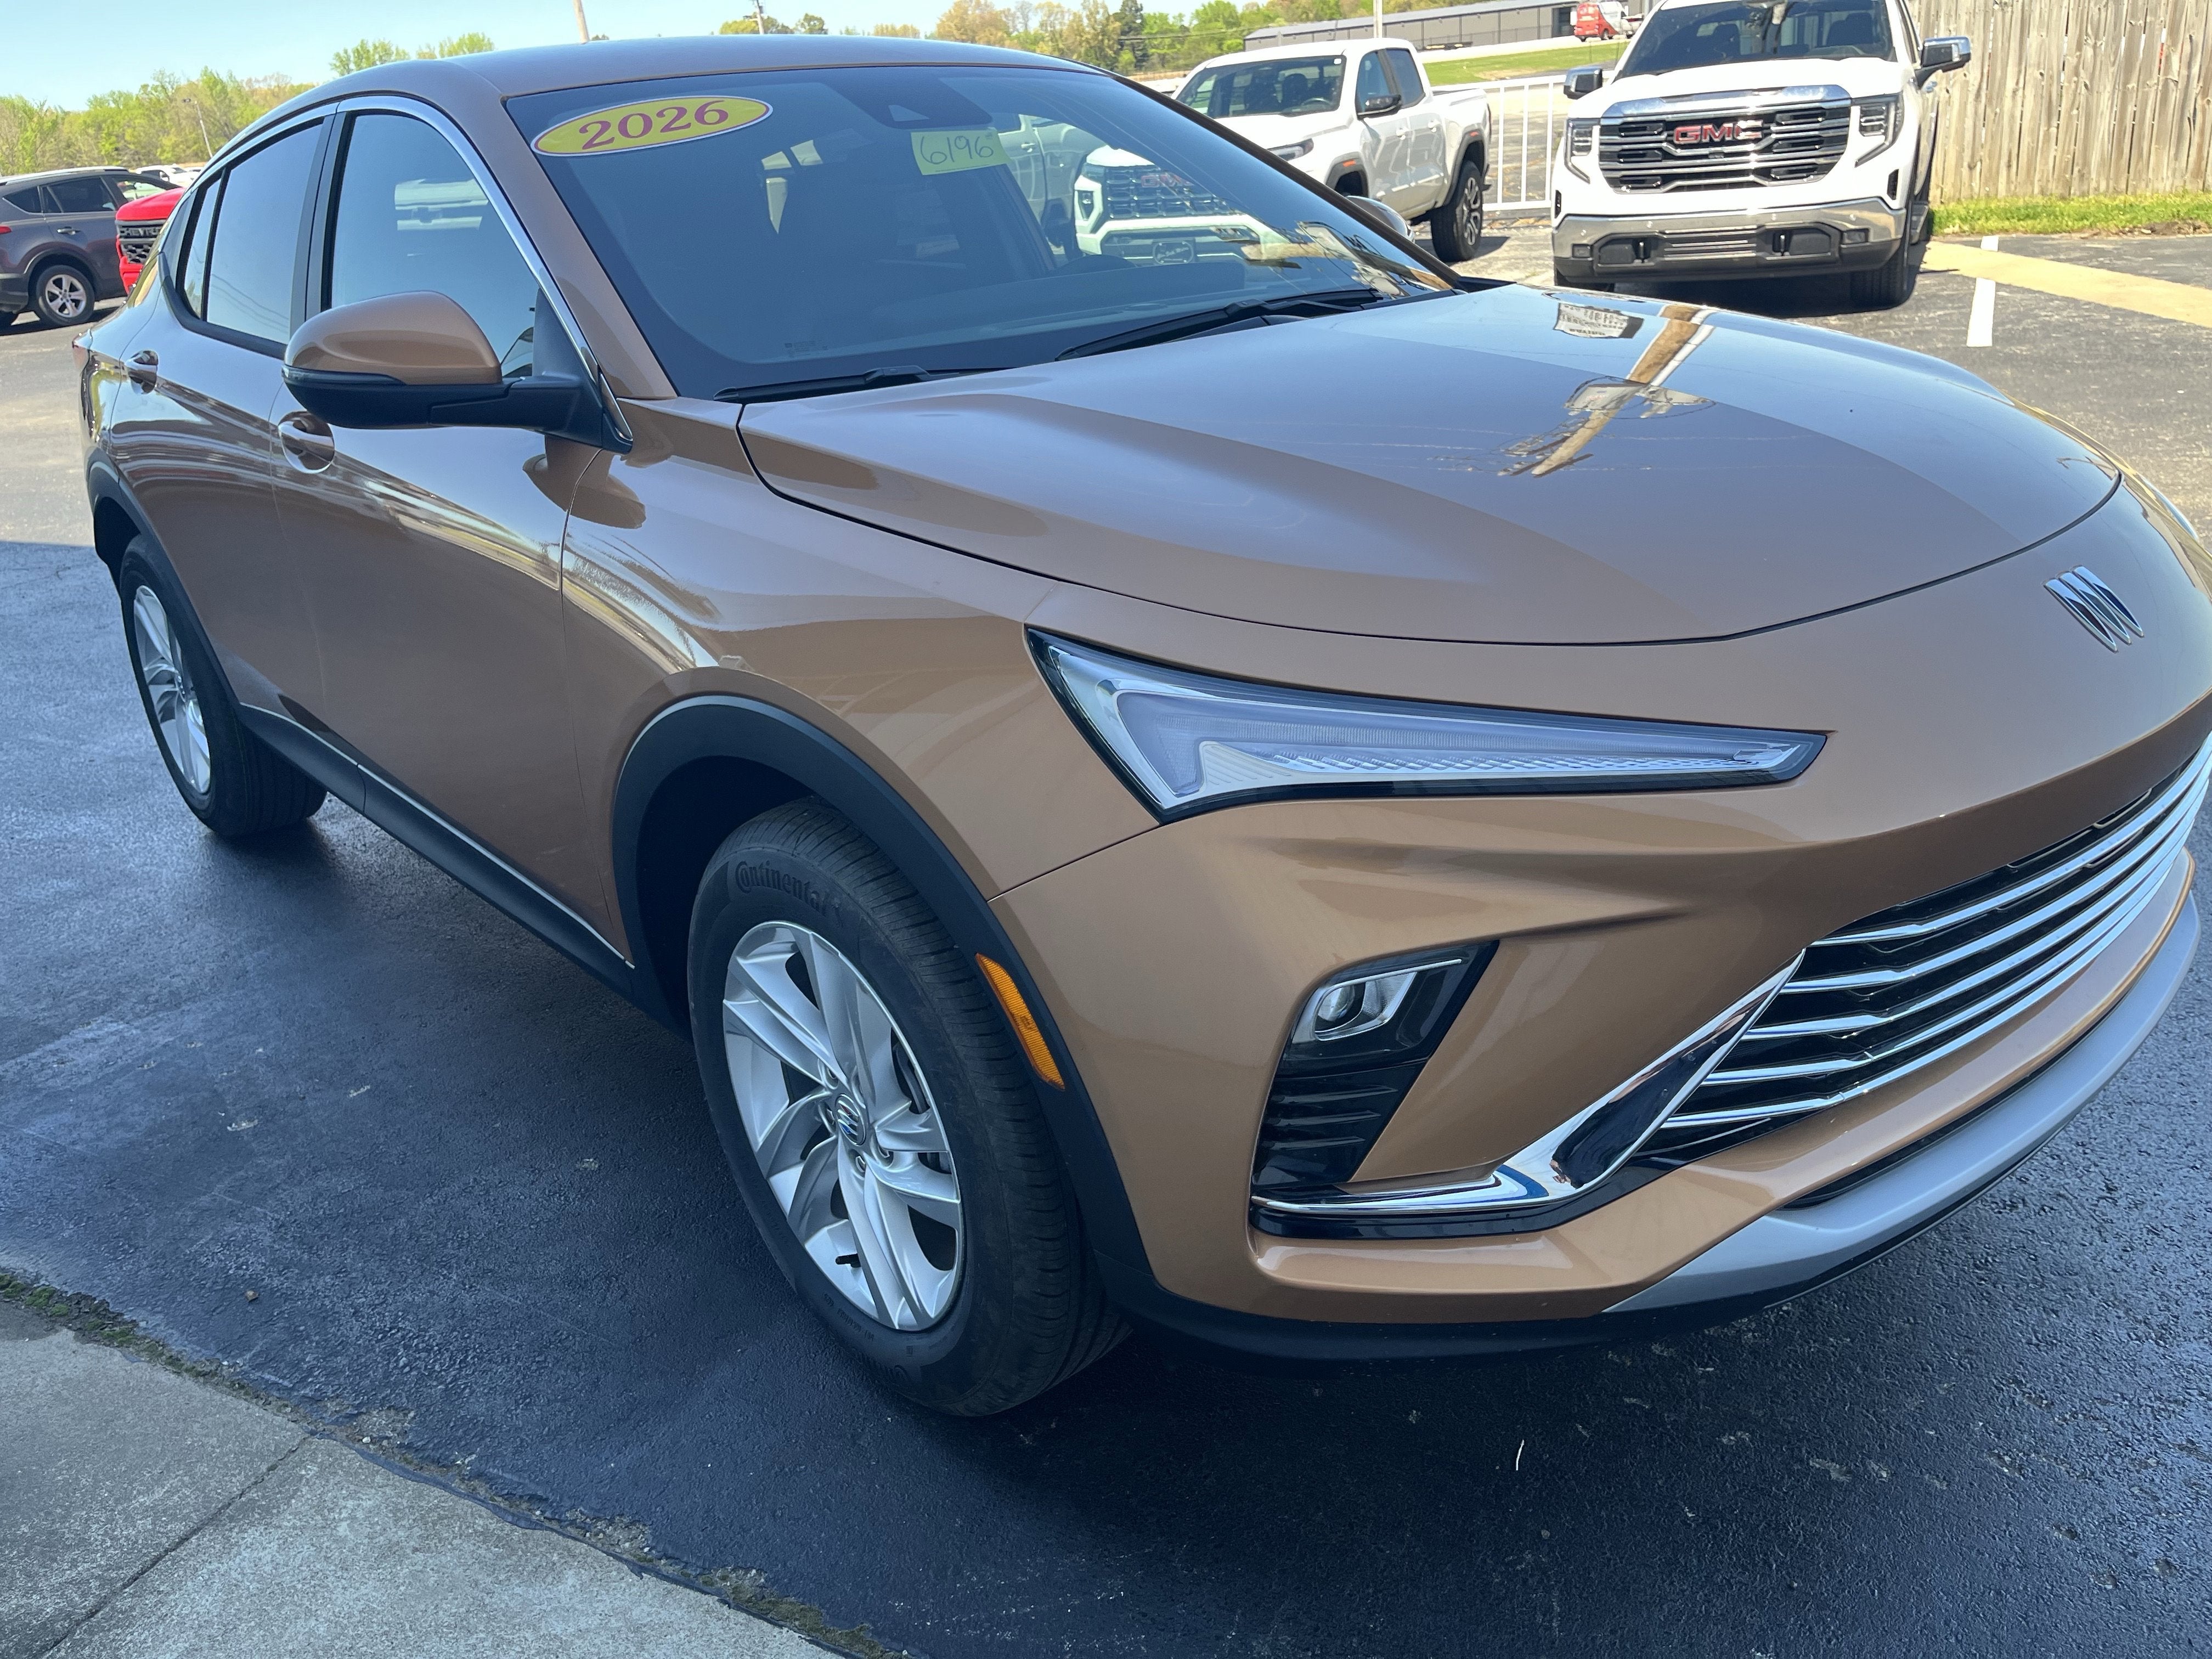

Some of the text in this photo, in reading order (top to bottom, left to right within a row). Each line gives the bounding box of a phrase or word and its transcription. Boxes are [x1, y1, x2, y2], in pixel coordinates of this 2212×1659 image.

[579, 100, 729, 150] 2026
[1674, 121, 1763, 144] GMC
[921, 136, 994, 165] 6196
[736, 860, 830, 917] Continental
